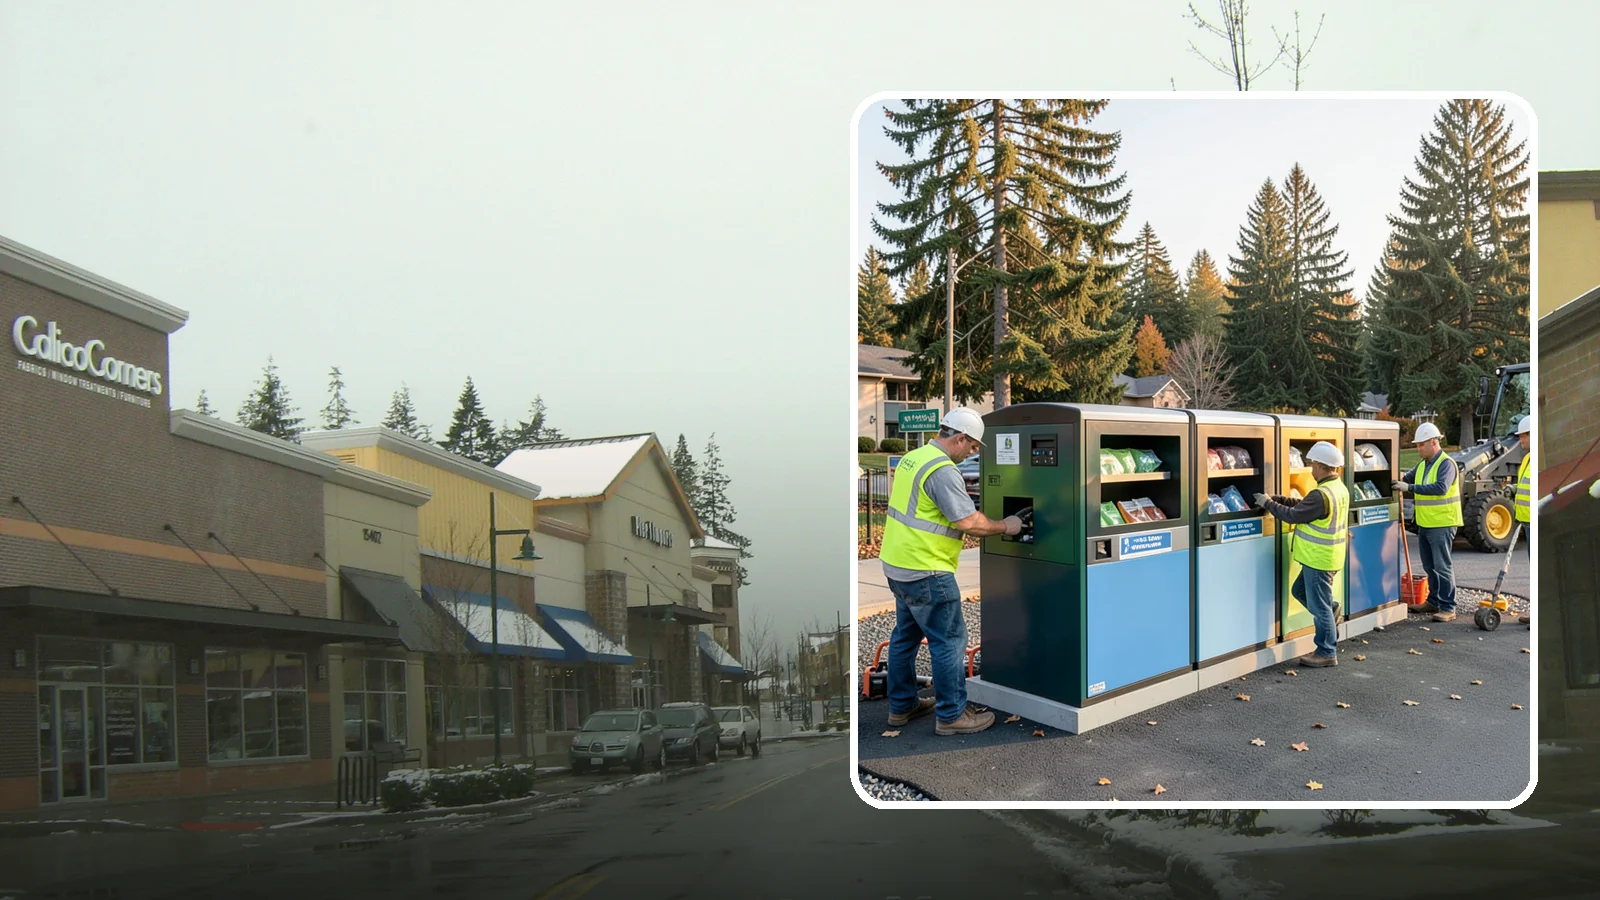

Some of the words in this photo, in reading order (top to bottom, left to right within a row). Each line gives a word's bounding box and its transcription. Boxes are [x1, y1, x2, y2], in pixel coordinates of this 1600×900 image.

[17, 360, 47, 378] FABRICS
[51, 370, 78, 387] WINDOW
[78, 379, 117, 398] TREATMENTS
